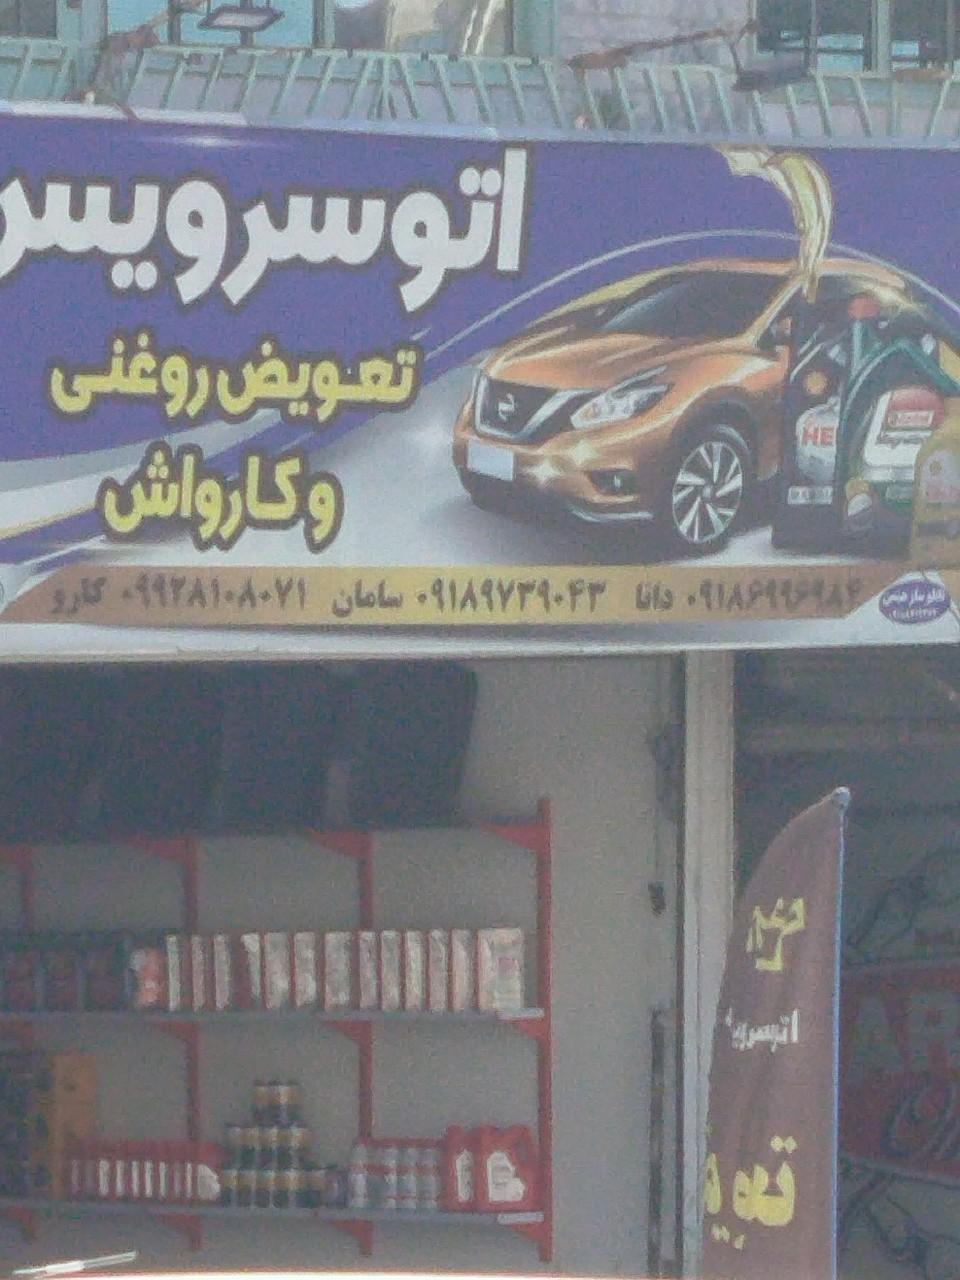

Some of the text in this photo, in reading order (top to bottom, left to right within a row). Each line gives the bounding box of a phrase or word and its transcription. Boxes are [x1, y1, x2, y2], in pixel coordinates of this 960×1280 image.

[49, 332, 418, 423] تعویض روغنی
[331, 578, 403, 618] سامان
[417, 577, 607, 614] ۰۹۱۸۹۷۳۹۰۴۳
